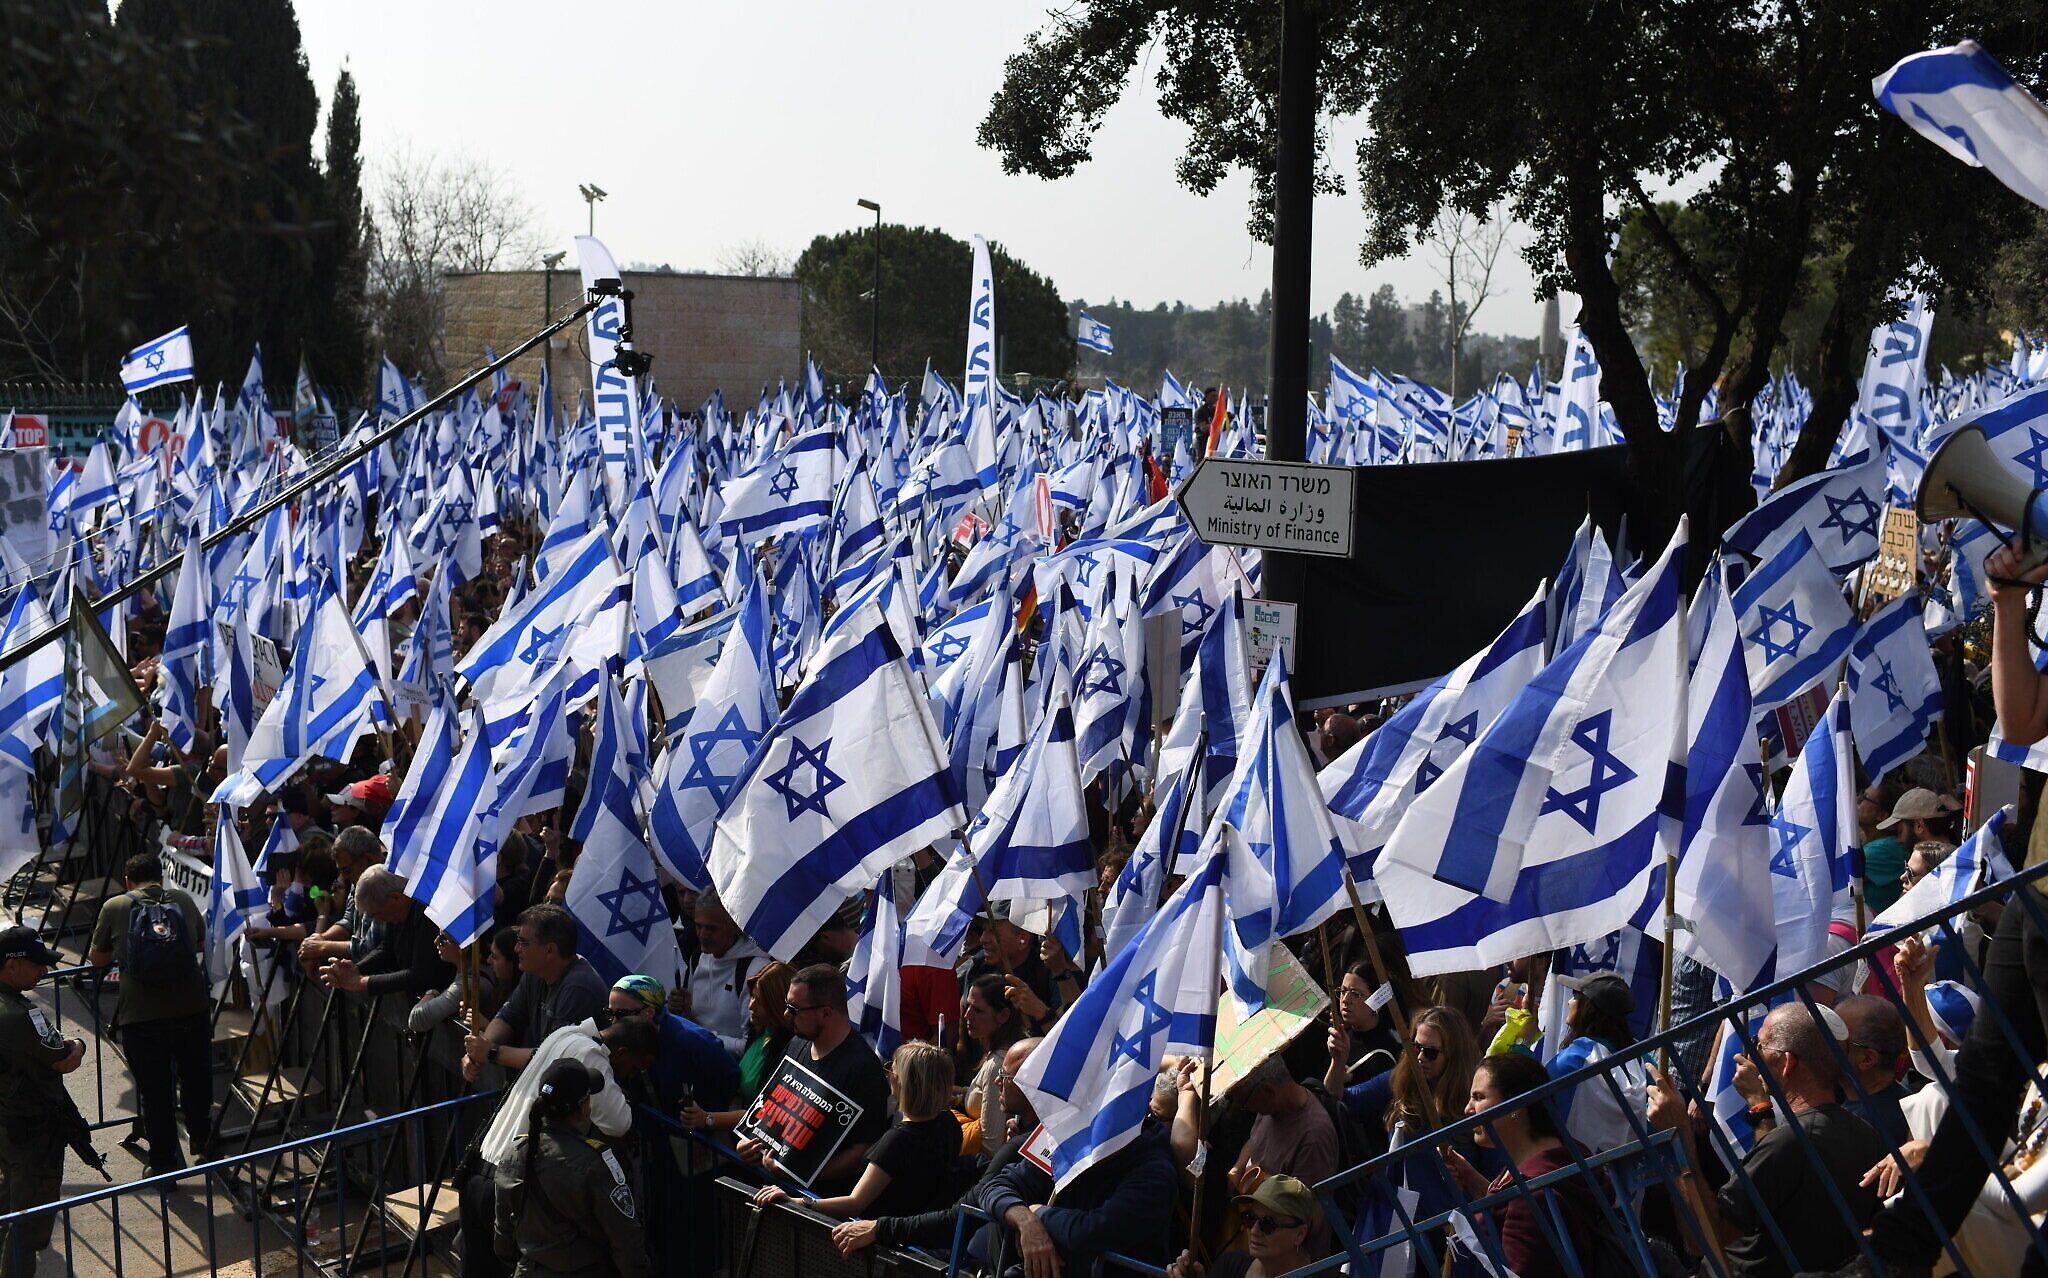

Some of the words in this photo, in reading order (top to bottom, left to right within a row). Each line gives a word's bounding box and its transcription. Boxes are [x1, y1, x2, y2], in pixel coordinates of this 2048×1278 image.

[16, 428, 44, 444] TOP
[1221, 471, 1271, 490] האוצר
[1278, 475, 1331, 494] משרד
[1223, 495, 1271, 515] المالية
[1279, 501, 1325, 524] وزارة
[1208, 517, 1261, 540] Ministry
[1266, 524, 1281, 538] of
[1285, 524, 1340, 544] Finance
[782, 1073, 793, 1085] לא
[790, 1078, 802, 1092] היא
[800, 1086, 833, 1113] הממשלה
